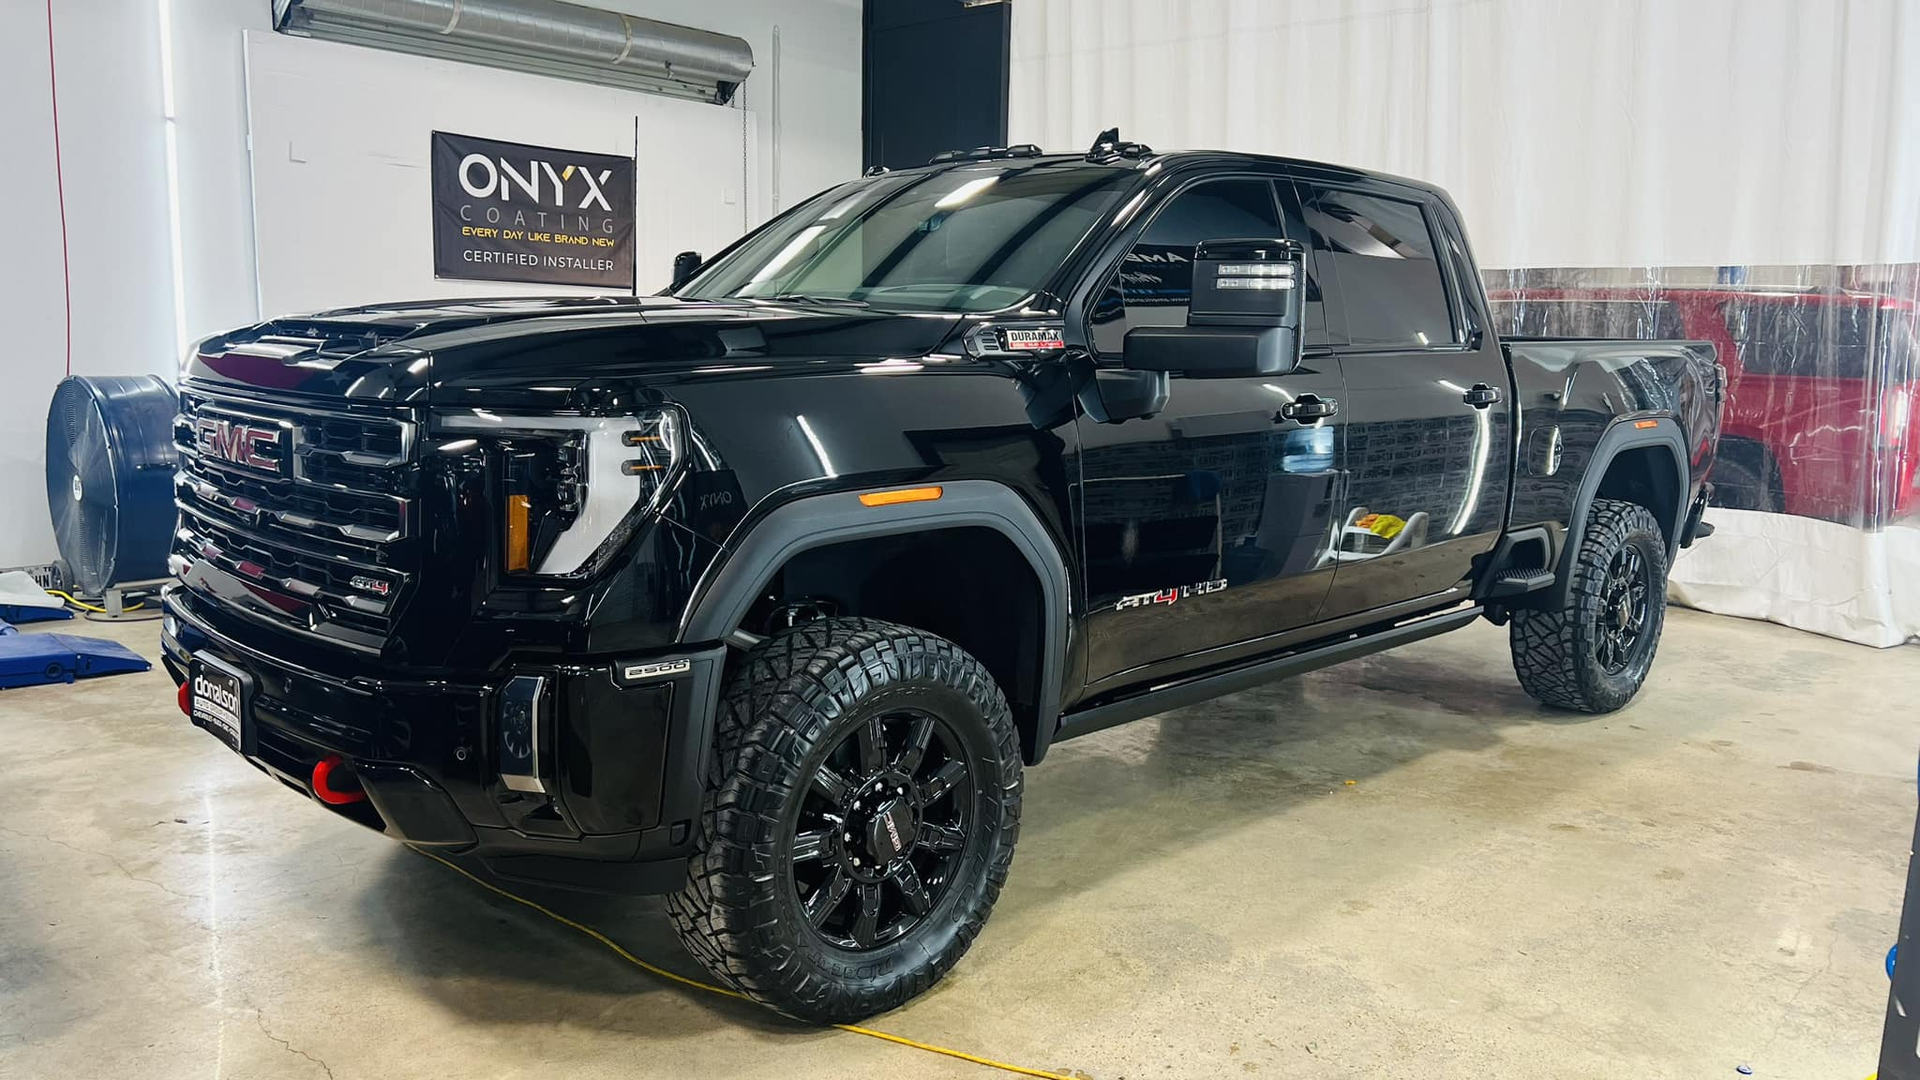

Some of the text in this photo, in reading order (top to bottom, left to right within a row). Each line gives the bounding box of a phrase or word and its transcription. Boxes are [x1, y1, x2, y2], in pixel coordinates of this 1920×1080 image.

[458, 153, 613, 212] ONYX
[460, 204, 613, 234] COATING
[462, 226, 615, 247] EVERY DAY LIKE BRAND NEW
[463, 249, 614, 271] CERTIFIED INSTALLER
[1011, 331, 1060, 341] DURAMAX
[197, 418, 281, 473] GMC
[1115, 587, 1178, 610] AT4
[628, 662, 688, 677] 2500
[194, 675, 239, 719] donalson
